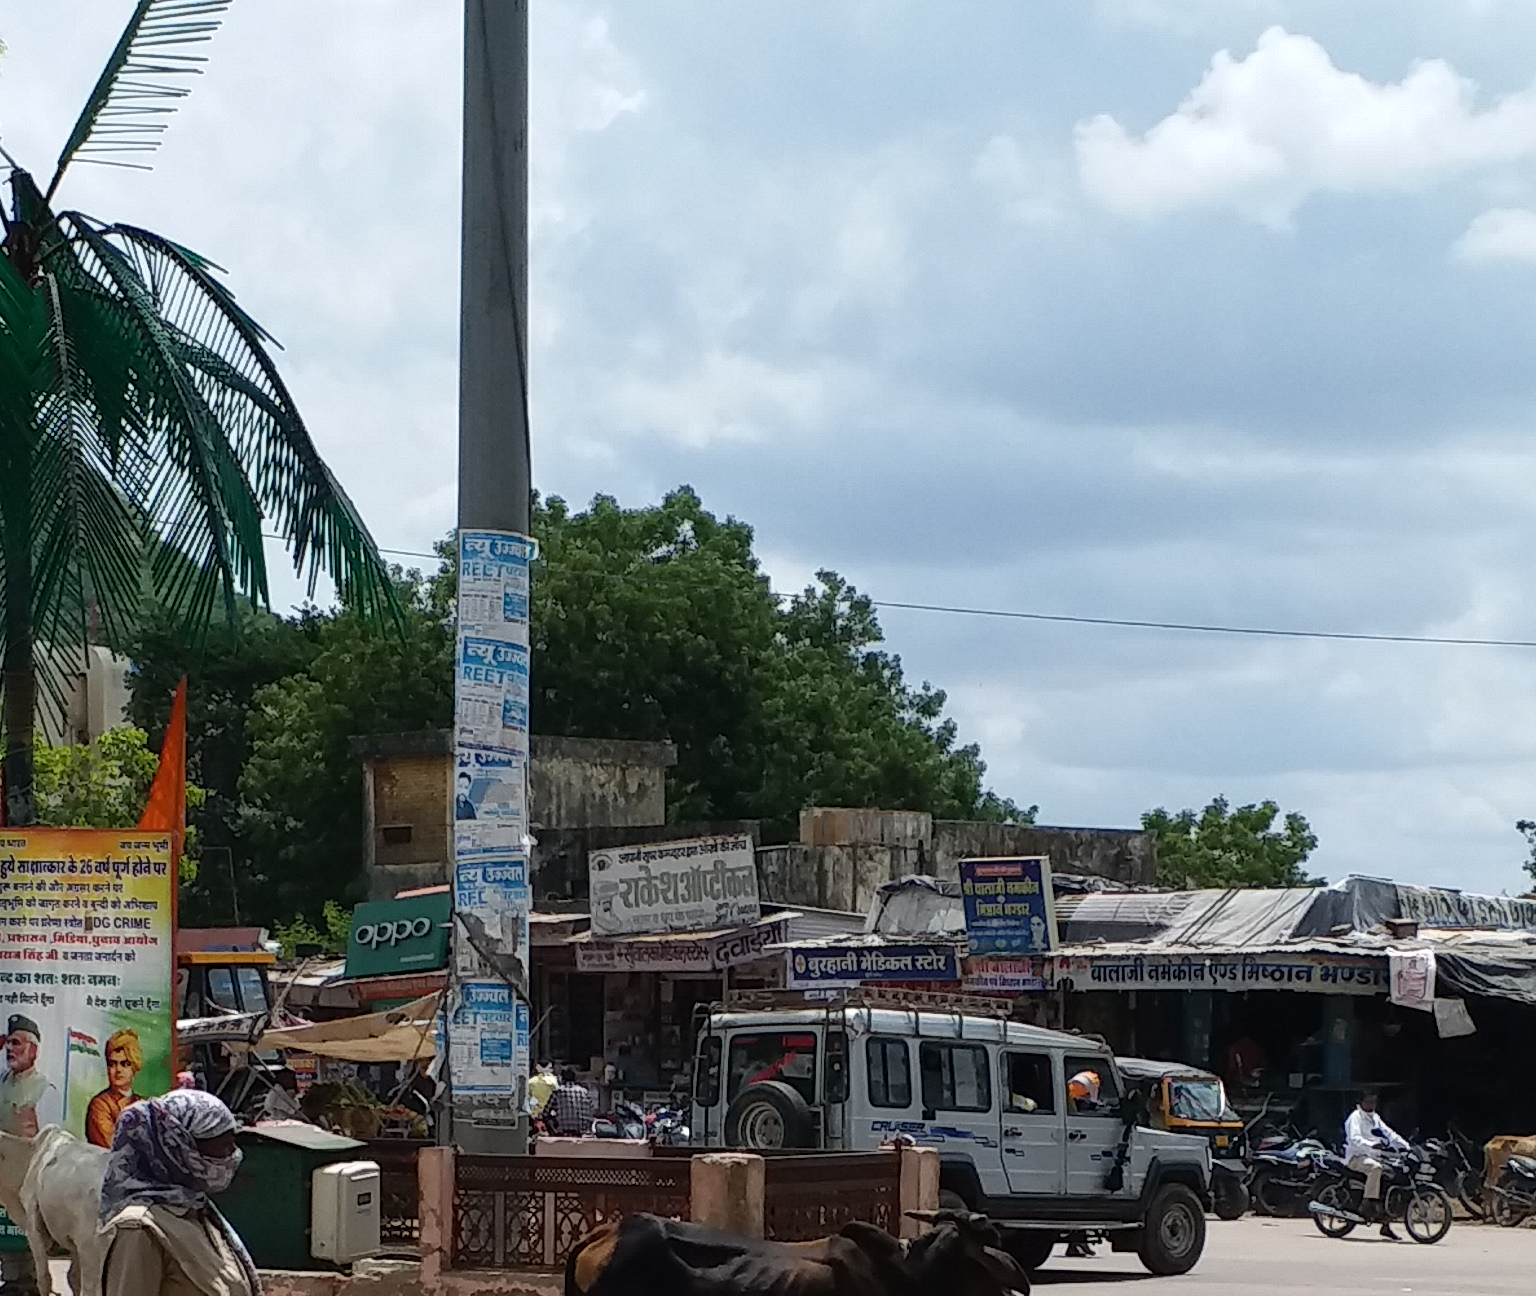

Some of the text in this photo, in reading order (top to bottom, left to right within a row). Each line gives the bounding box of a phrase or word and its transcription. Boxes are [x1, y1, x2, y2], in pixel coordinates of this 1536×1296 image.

[464, 666, 505, 684] REET
[68, 855, 78, 874] के
[94, 855, 110, 874] वर्ष
[153, 861, 167, 876] पर
[113, 917, 151, 929] CRIME
[860, 951, 913, 972] मेडिकल
[914, 949, 946, 971] स्टोर
[15, 972, 31, 984] का
[1208, 963, 1237, 985] एण्ड
[1241, 956, 1312, 983] मिष्ठान
